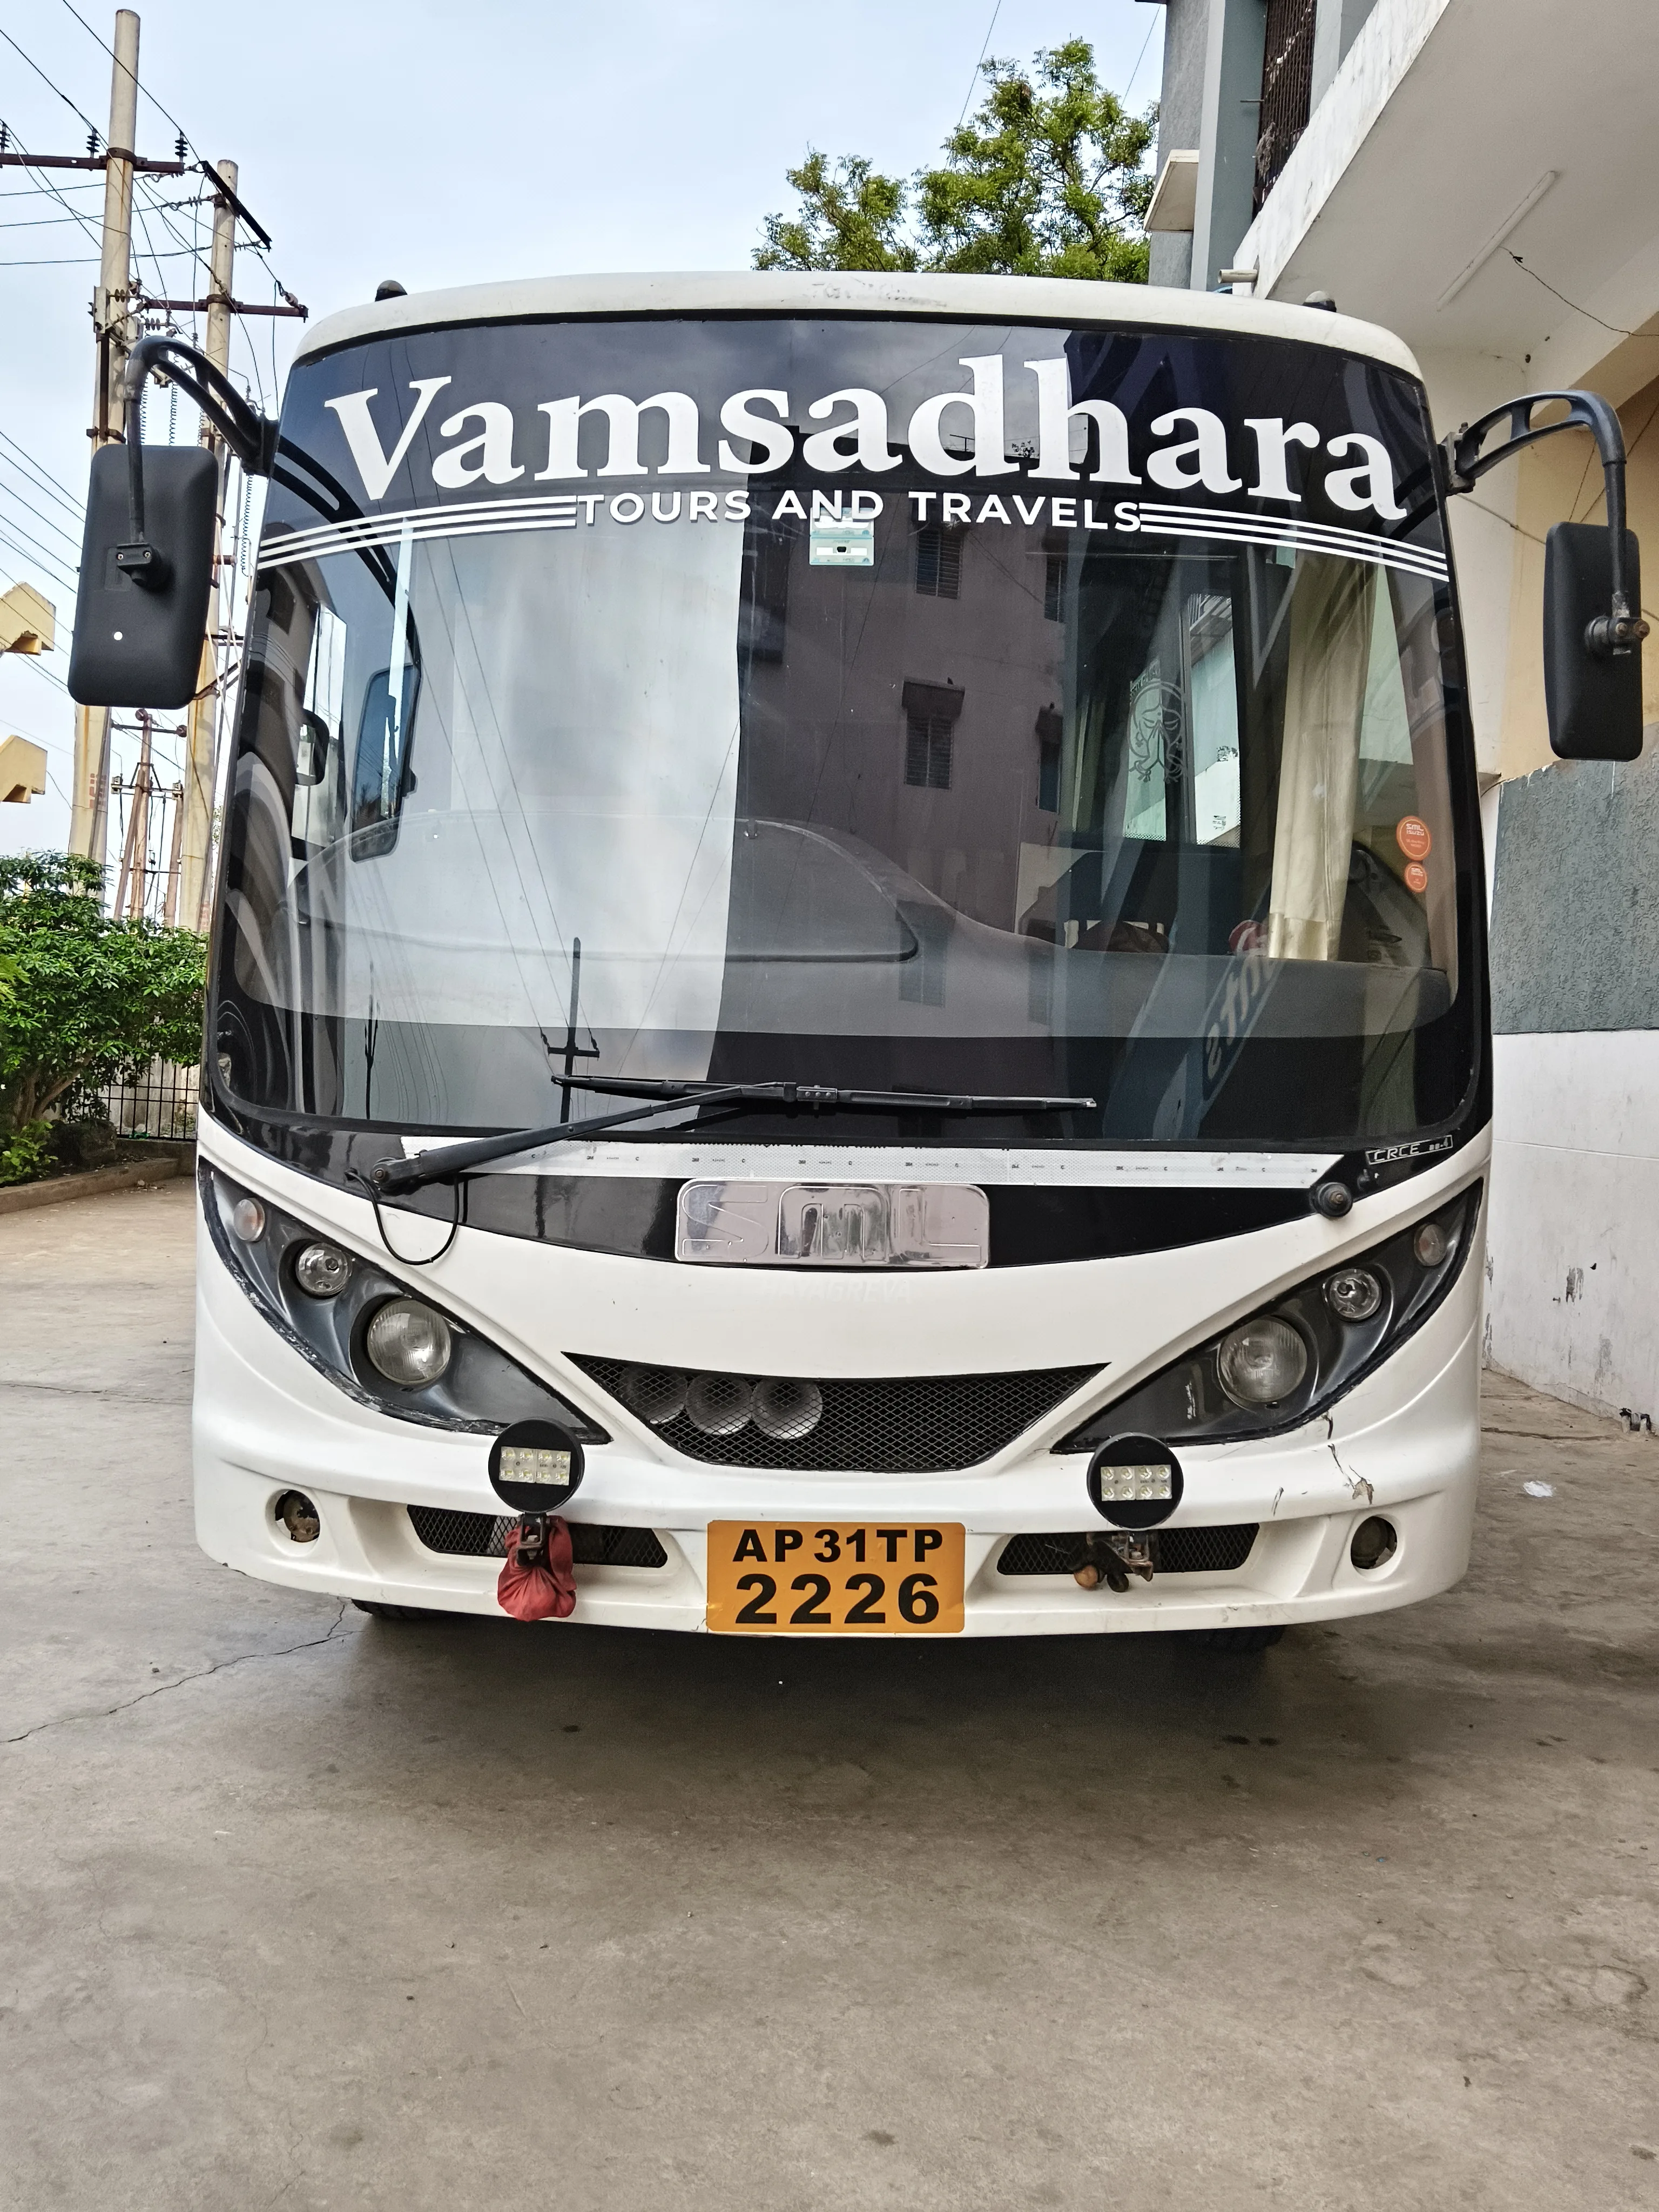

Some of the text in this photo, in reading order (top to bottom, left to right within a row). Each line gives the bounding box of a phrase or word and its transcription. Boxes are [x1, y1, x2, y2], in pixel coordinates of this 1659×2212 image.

[324, 354, 1407, 520] Vamsadhara
[577, 490, 1142, 532] TOURS AND TRAVELS
[732, 1529, 943, 1563] AP31TP
[735, 1573, 940, 1624] 2226
